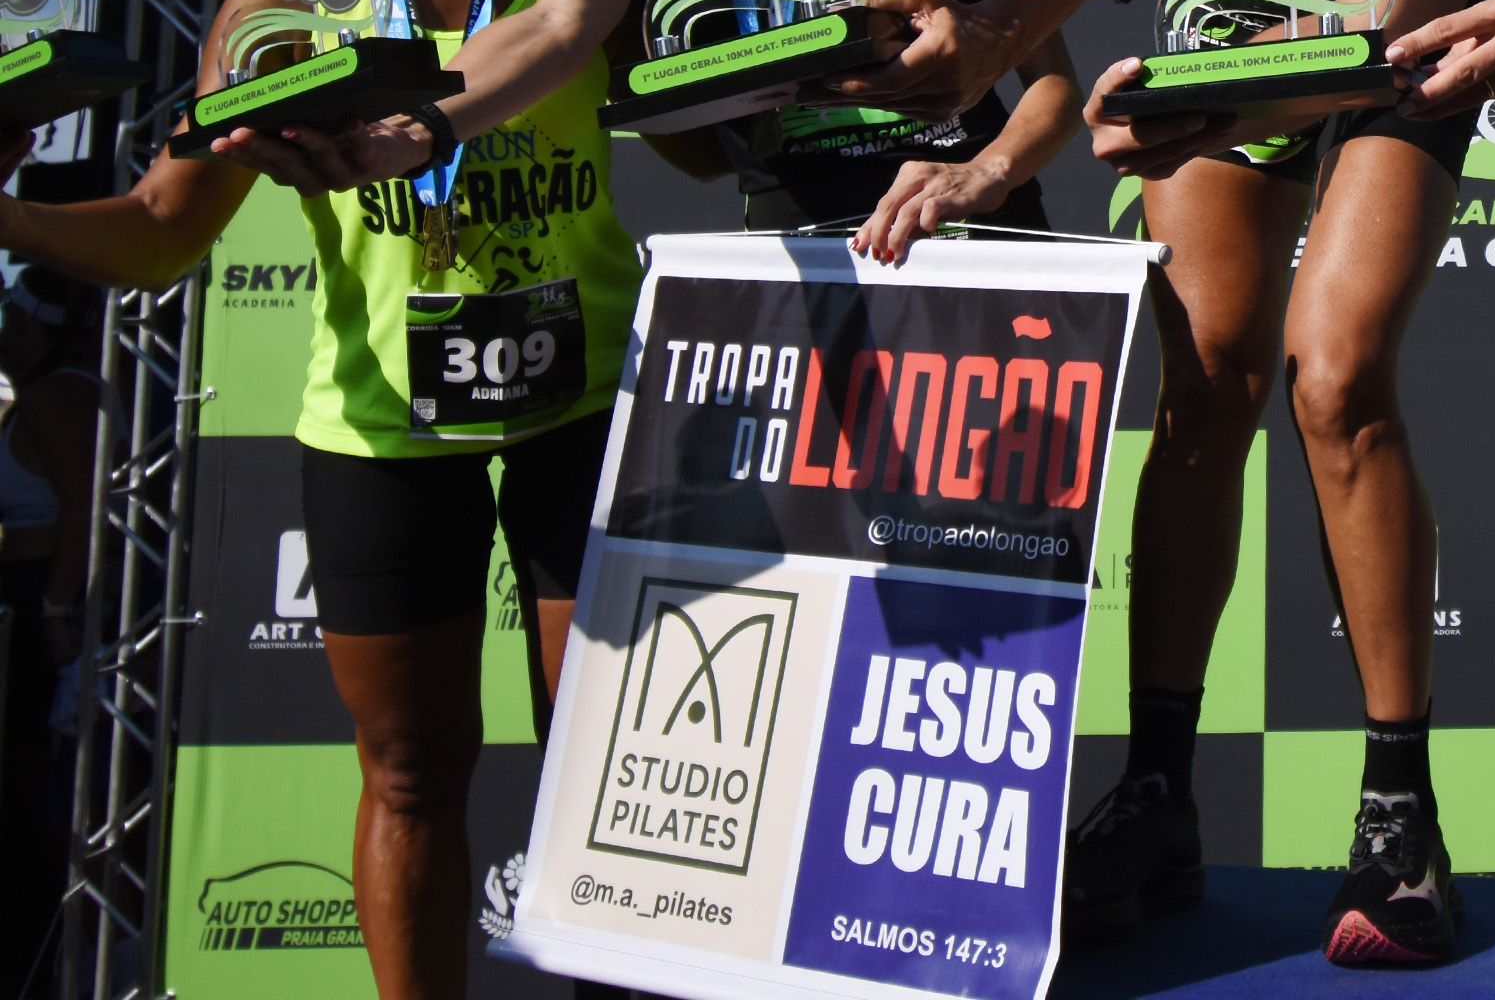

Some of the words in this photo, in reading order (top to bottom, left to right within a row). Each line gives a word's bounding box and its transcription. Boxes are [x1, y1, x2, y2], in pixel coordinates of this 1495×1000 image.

[2, 51, 41, 73] FEMININO
[653, 65, 687, 80] LUGAR
[690, 56, 725, 71] GERAL
[726, 48, 753, 62] 10KM
[756, 41, 779, 54] CAT.
[781, 27, 832, 48] FEMININO
[1166, 64, 1202, 75] LUGAR
[1204, 60, 1239, 71] GERAL
[1242, 56, 1270, 67] 10KM
[1274, 53, 1298, 64] CAT.
[1300, 47, 1355, 61] FEMININO
[214, 97, 239, 112] LUGAR
[241, 87, 267, 103] GERAL
[268, 80, 288, 93] 10KM
[290, 72, 307, 85] CAT.
[308, 58, 348, 79] FEMININO
[223, 299, 295, 308] ACADEMIA
[443, 331, 556, 384] 309
[665, 341, 799, 410] TROPA
[472, 384, 529, 401] ADRIANA
[789, 314, 1103, 509] LONGÃO
[730, 417, 787, 482] DO
[868, 514, 1070, 559] @tropadolongao
[250, 624, 303, 639] ART
[850, 655, 1056, 770] JESUS
[617, 753, 748, 805] STUDIO
[609, 800, 739, 851] PILATES
[844, 768, 1029, 888] CURA
[206, 901, 272, 925] AUTO
[571, 874, 733, 925] @m.a._pilates
[281, 931, 324, 945] PRAIA
[831, 915, 936, 956] SALMOS
[944, 935, 1007, 968] 147:3
